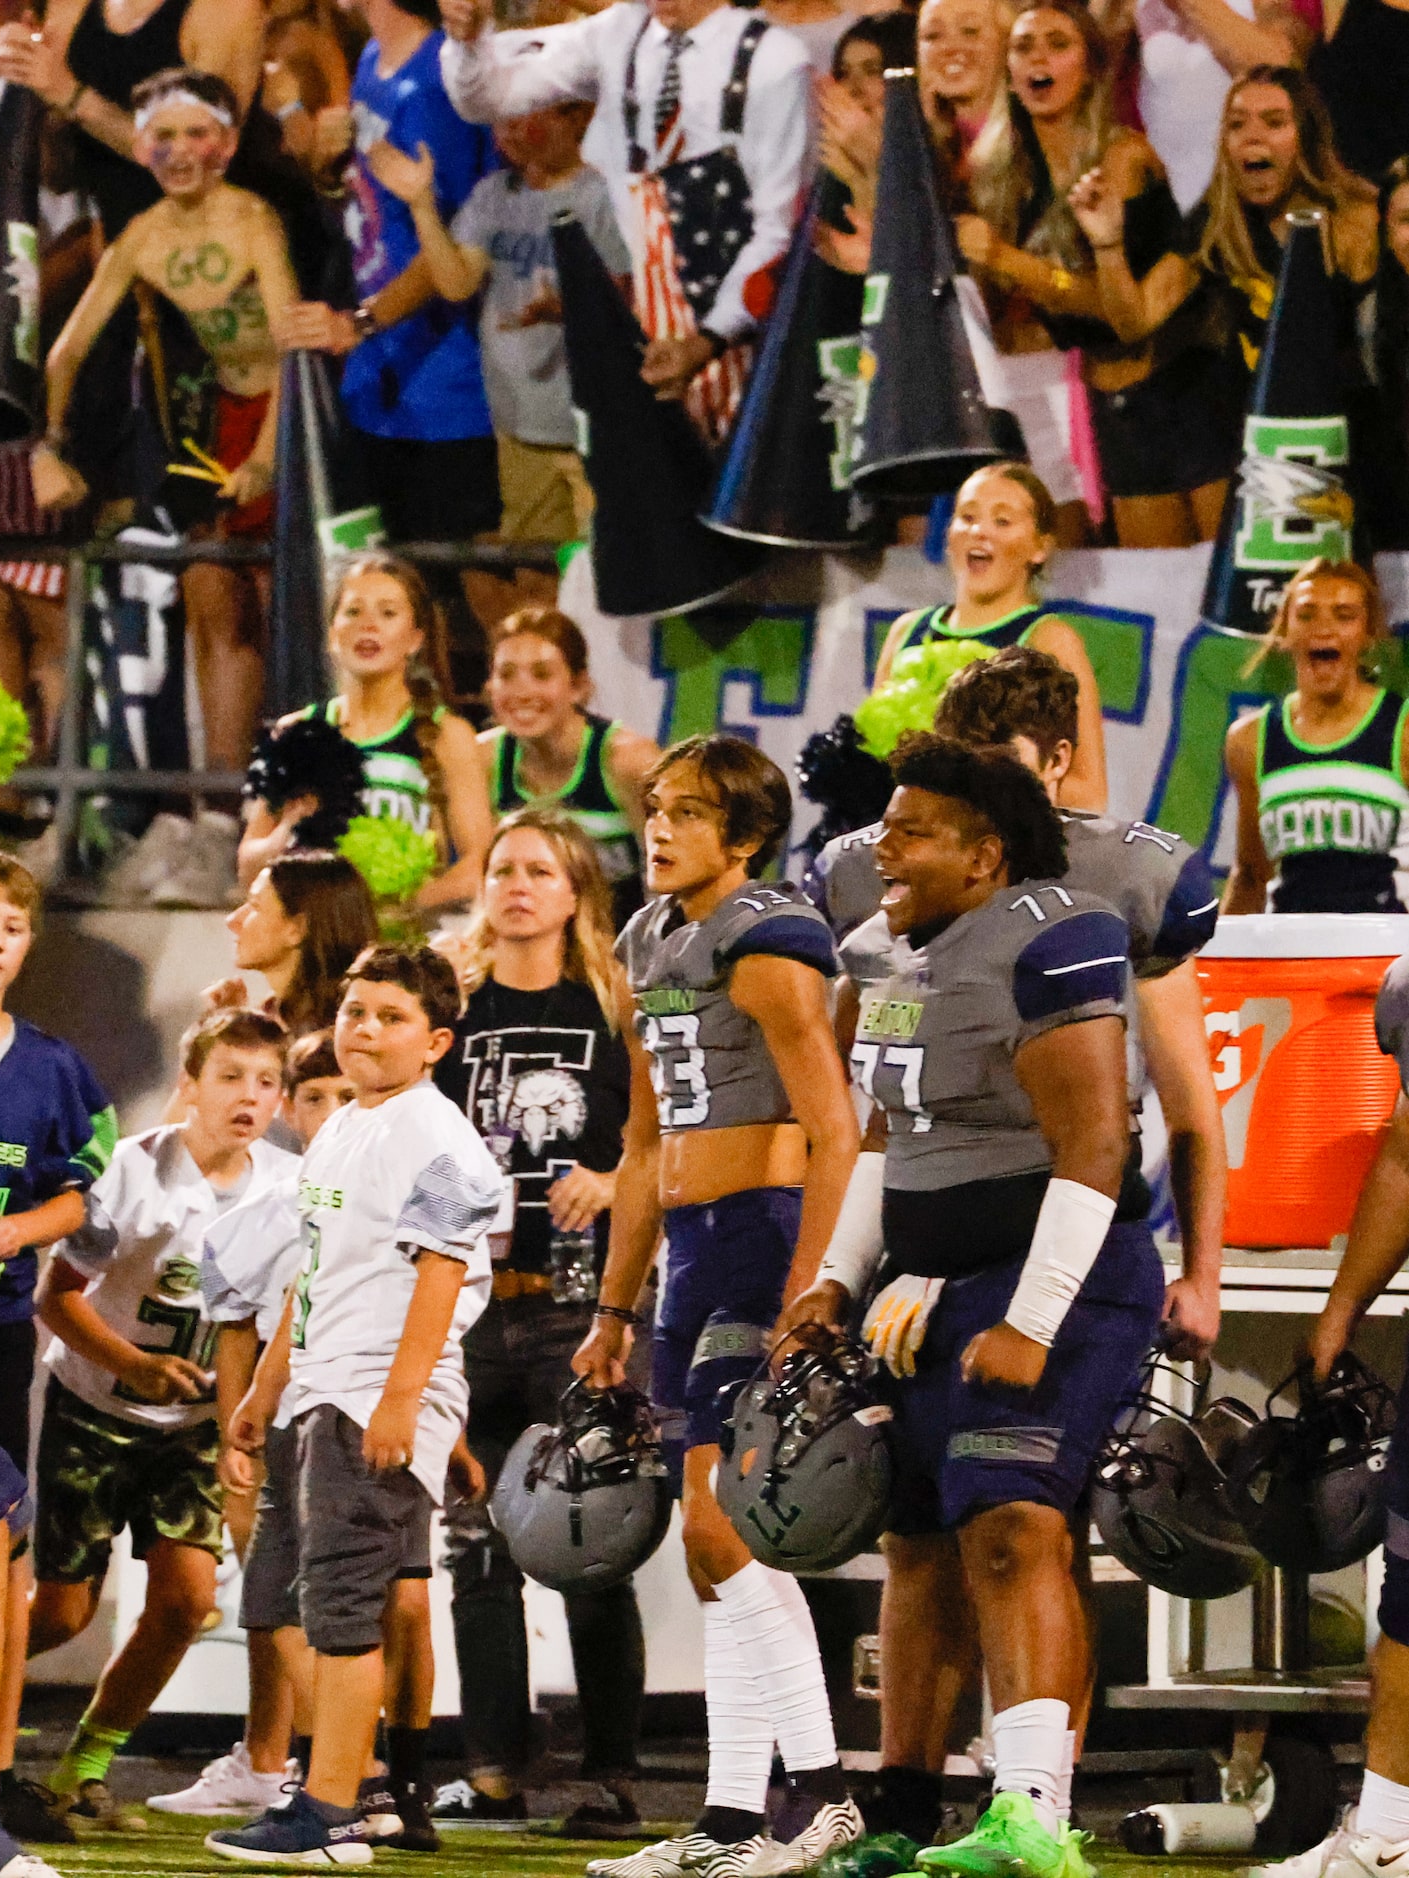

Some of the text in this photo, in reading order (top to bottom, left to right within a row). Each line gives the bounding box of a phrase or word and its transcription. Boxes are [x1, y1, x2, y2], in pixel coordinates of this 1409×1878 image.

[165, 242, 232, 290] GO
[1259, 798, 1393, 860] EATON
[1008, 885, 1075, 922] 77
[850, 1041, 934, 1134] 77
